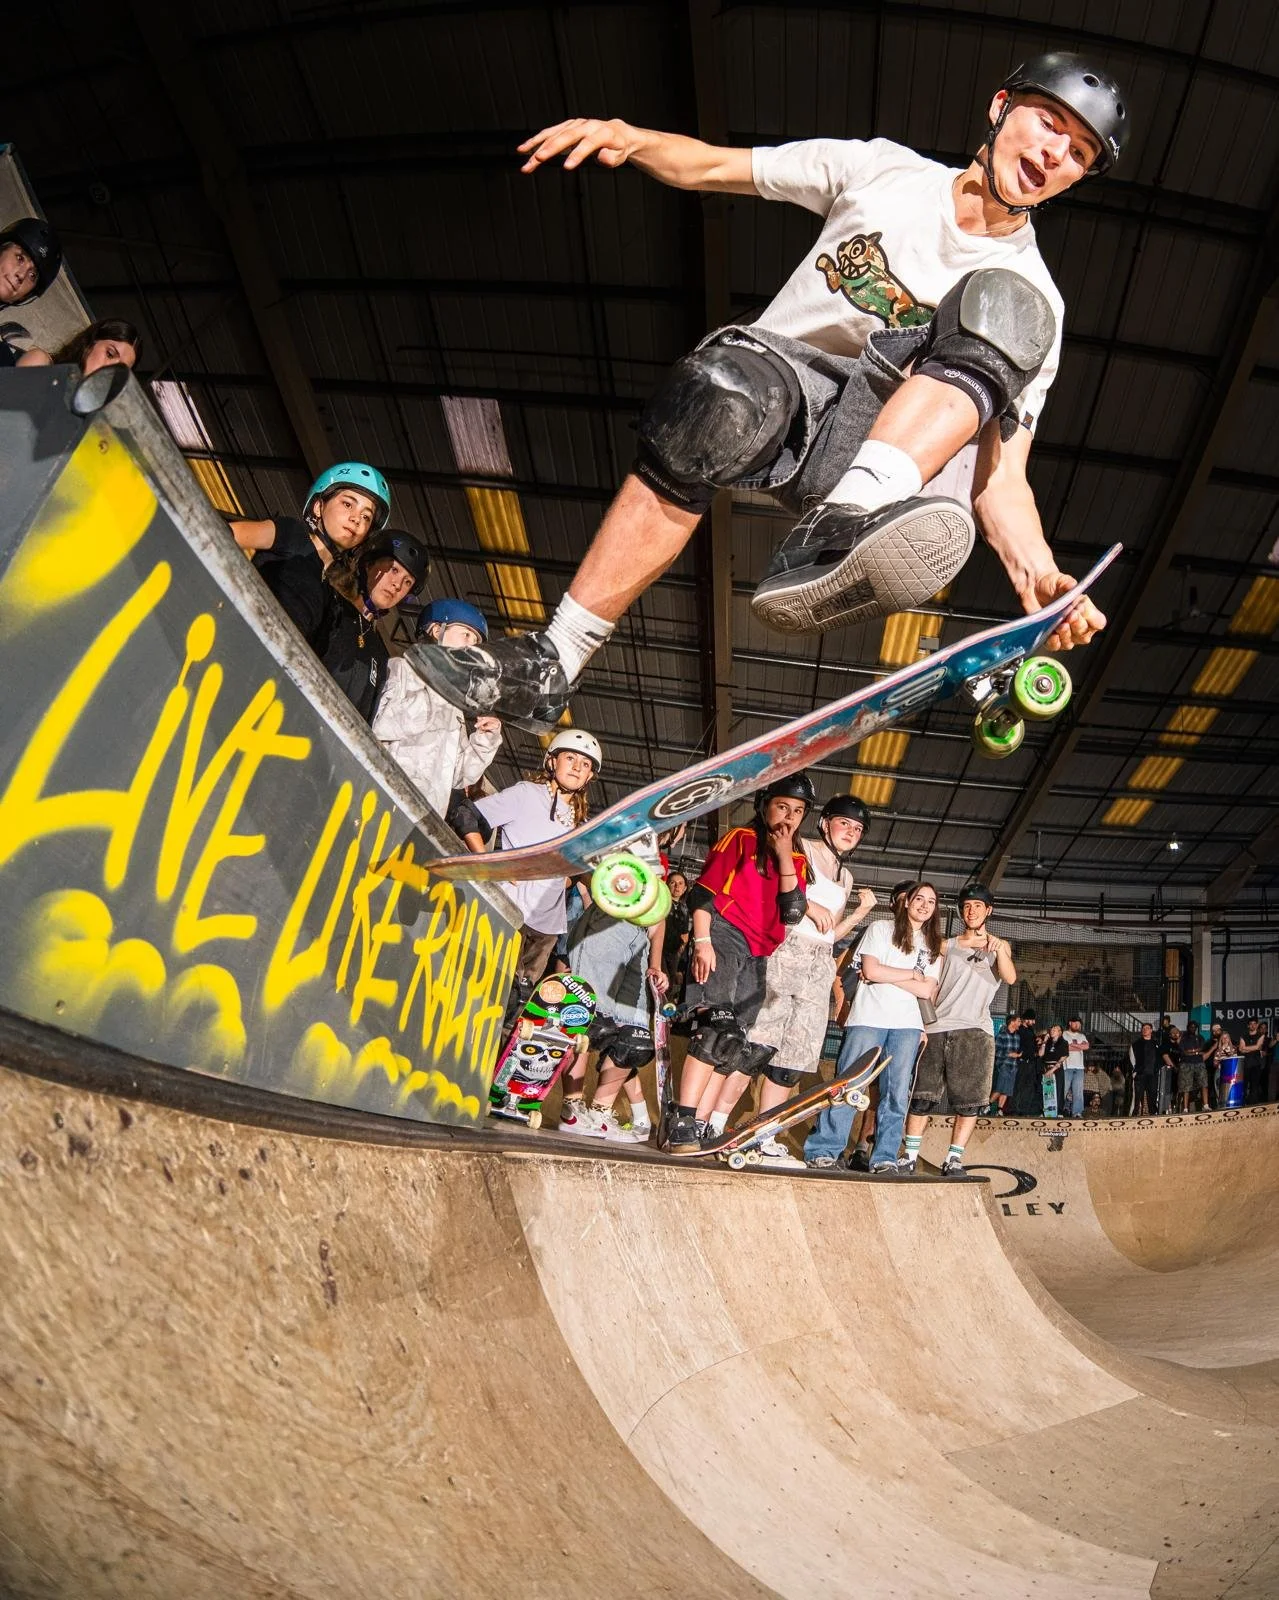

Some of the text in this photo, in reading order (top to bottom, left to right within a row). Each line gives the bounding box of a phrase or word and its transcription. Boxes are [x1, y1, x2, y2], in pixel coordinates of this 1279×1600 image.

[0, 560, 512, 1077] LIVE LIKE RALPH
[567, 981, 596, 1008] etnies
[1002, 1203, 1065, 1216] LEY
